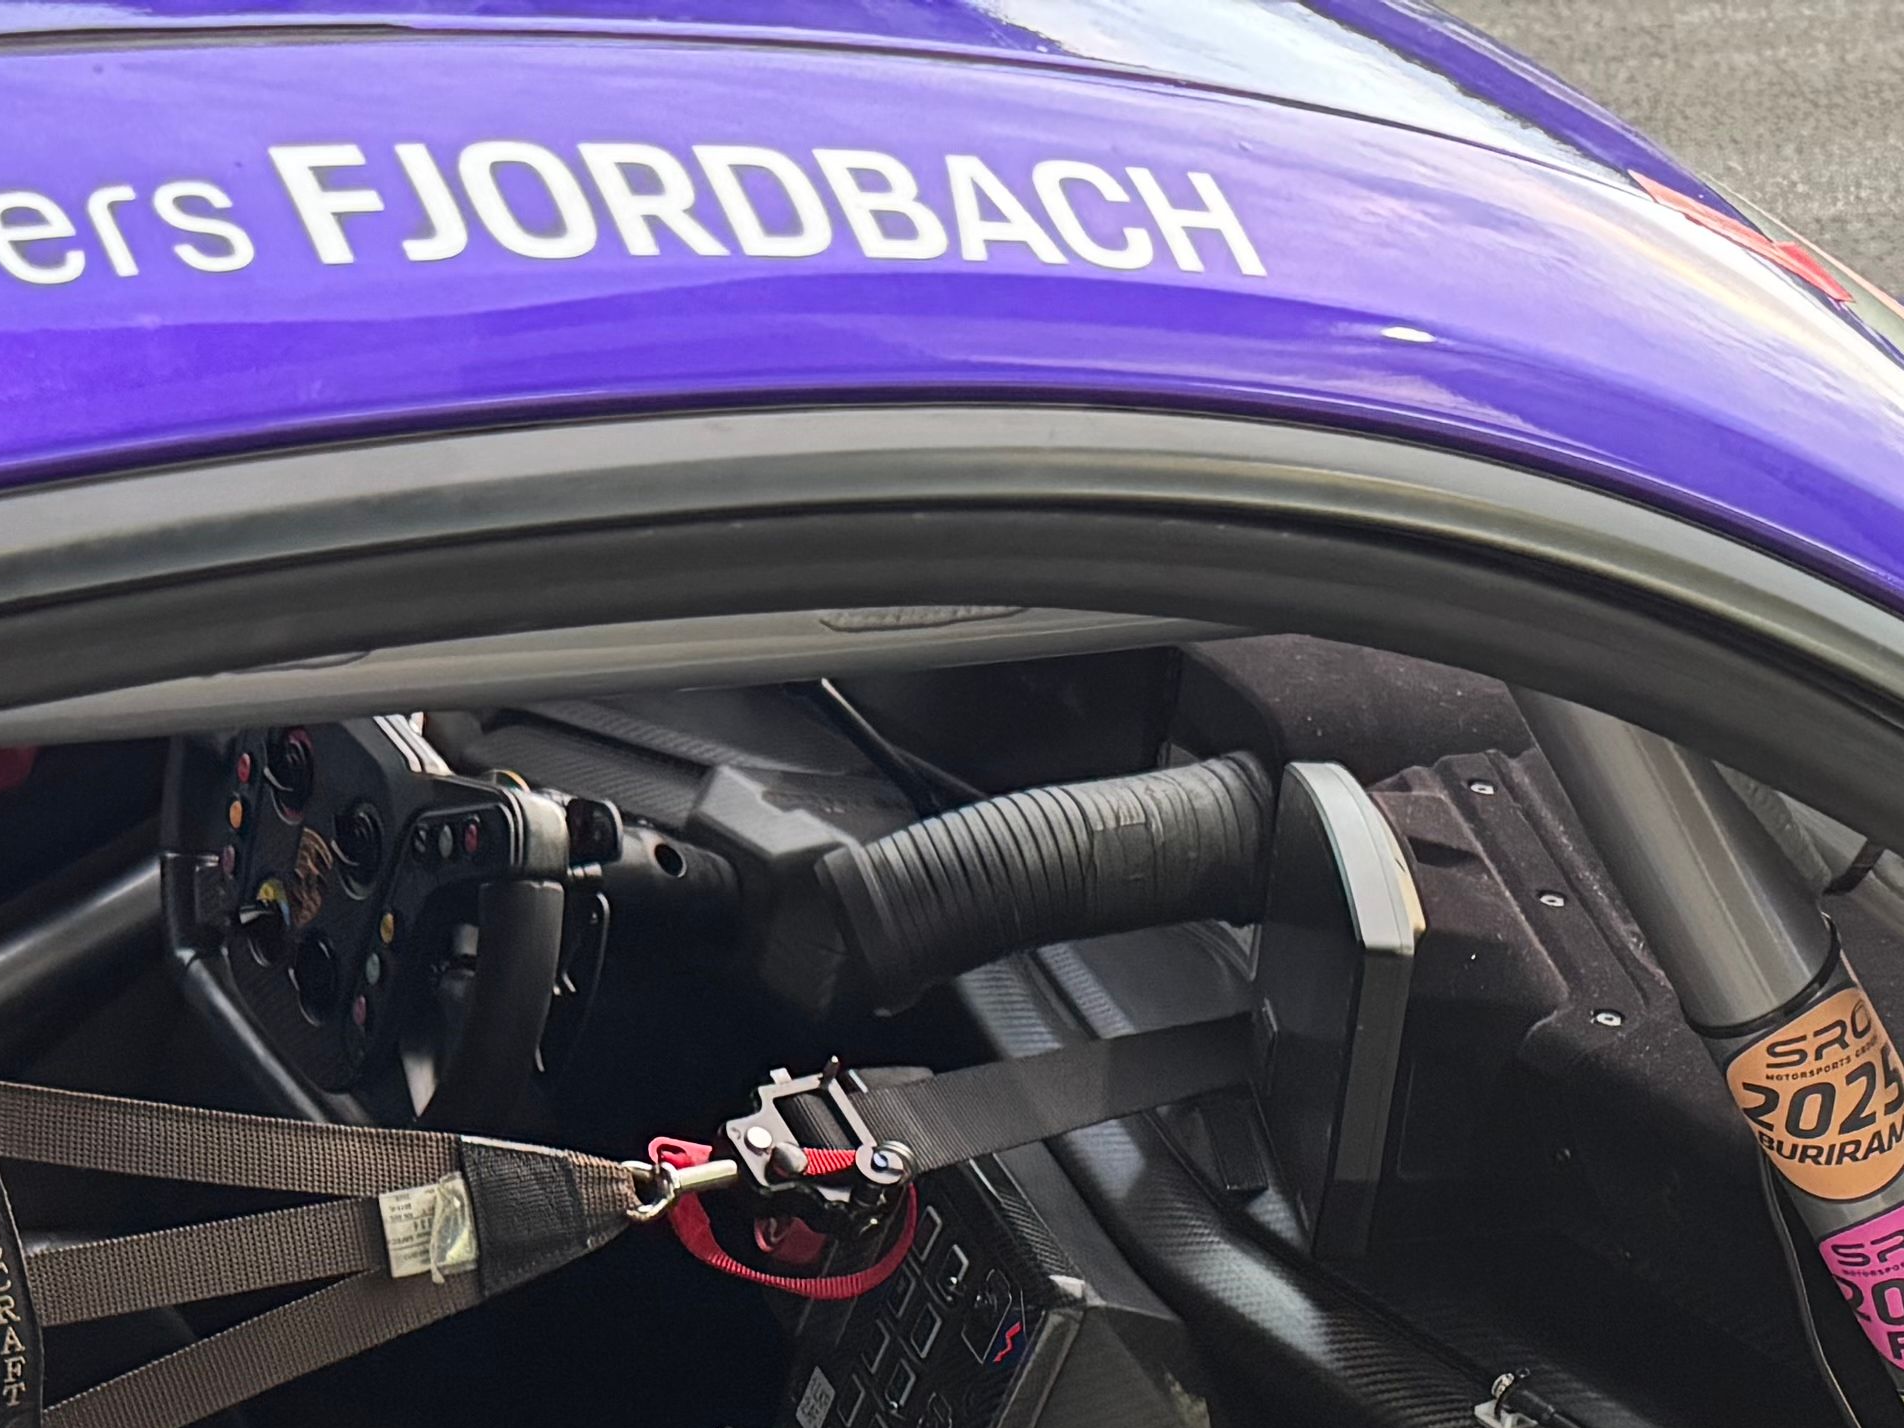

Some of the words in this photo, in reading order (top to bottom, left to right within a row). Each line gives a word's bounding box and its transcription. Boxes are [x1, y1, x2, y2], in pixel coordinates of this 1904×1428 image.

[268, 139, 1267, 277] FJORDBACH
[1765, 1056, 1852, 1081] MOTORSPORTS
[1766, 999, 1872, 1068] SRO
[1742, 1045, 1904, 1139] 2025
